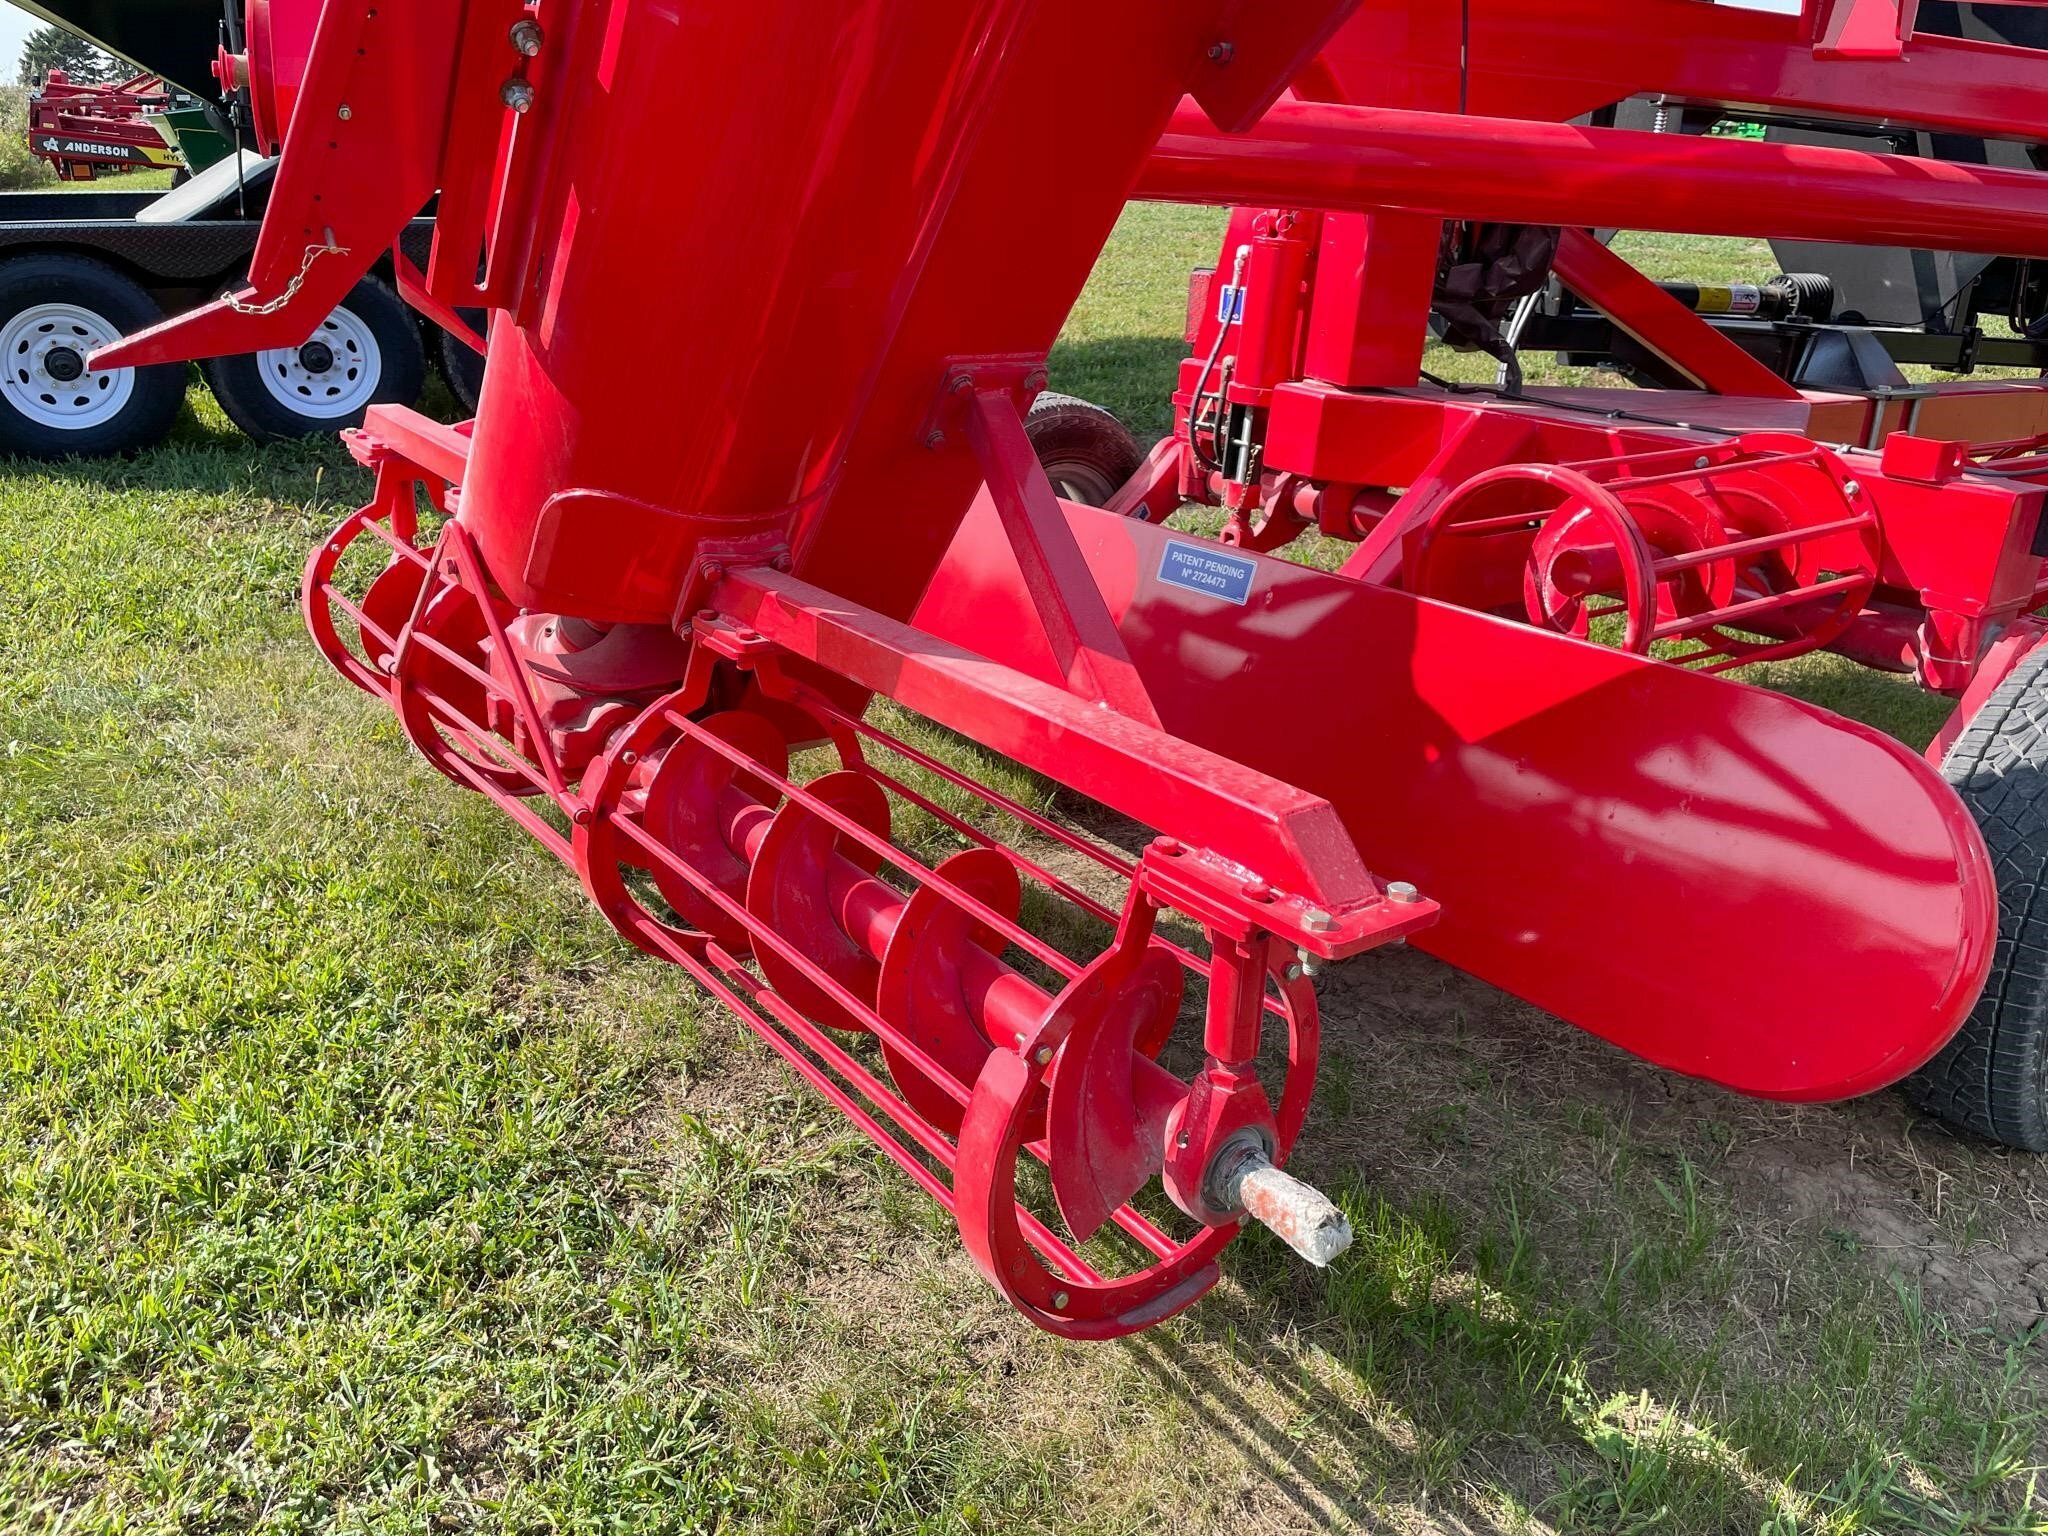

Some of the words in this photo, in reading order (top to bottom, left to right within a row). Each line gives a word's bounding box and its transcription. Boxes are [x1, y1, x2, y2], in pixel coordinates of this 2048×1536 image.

[64, 142, 129, 157] ANDERSON
[1171, 551, 1205, 567] PATENT
[1205, 561, 1245, 579] PENDING
[1192, 571, 1226, 588] 2724473
